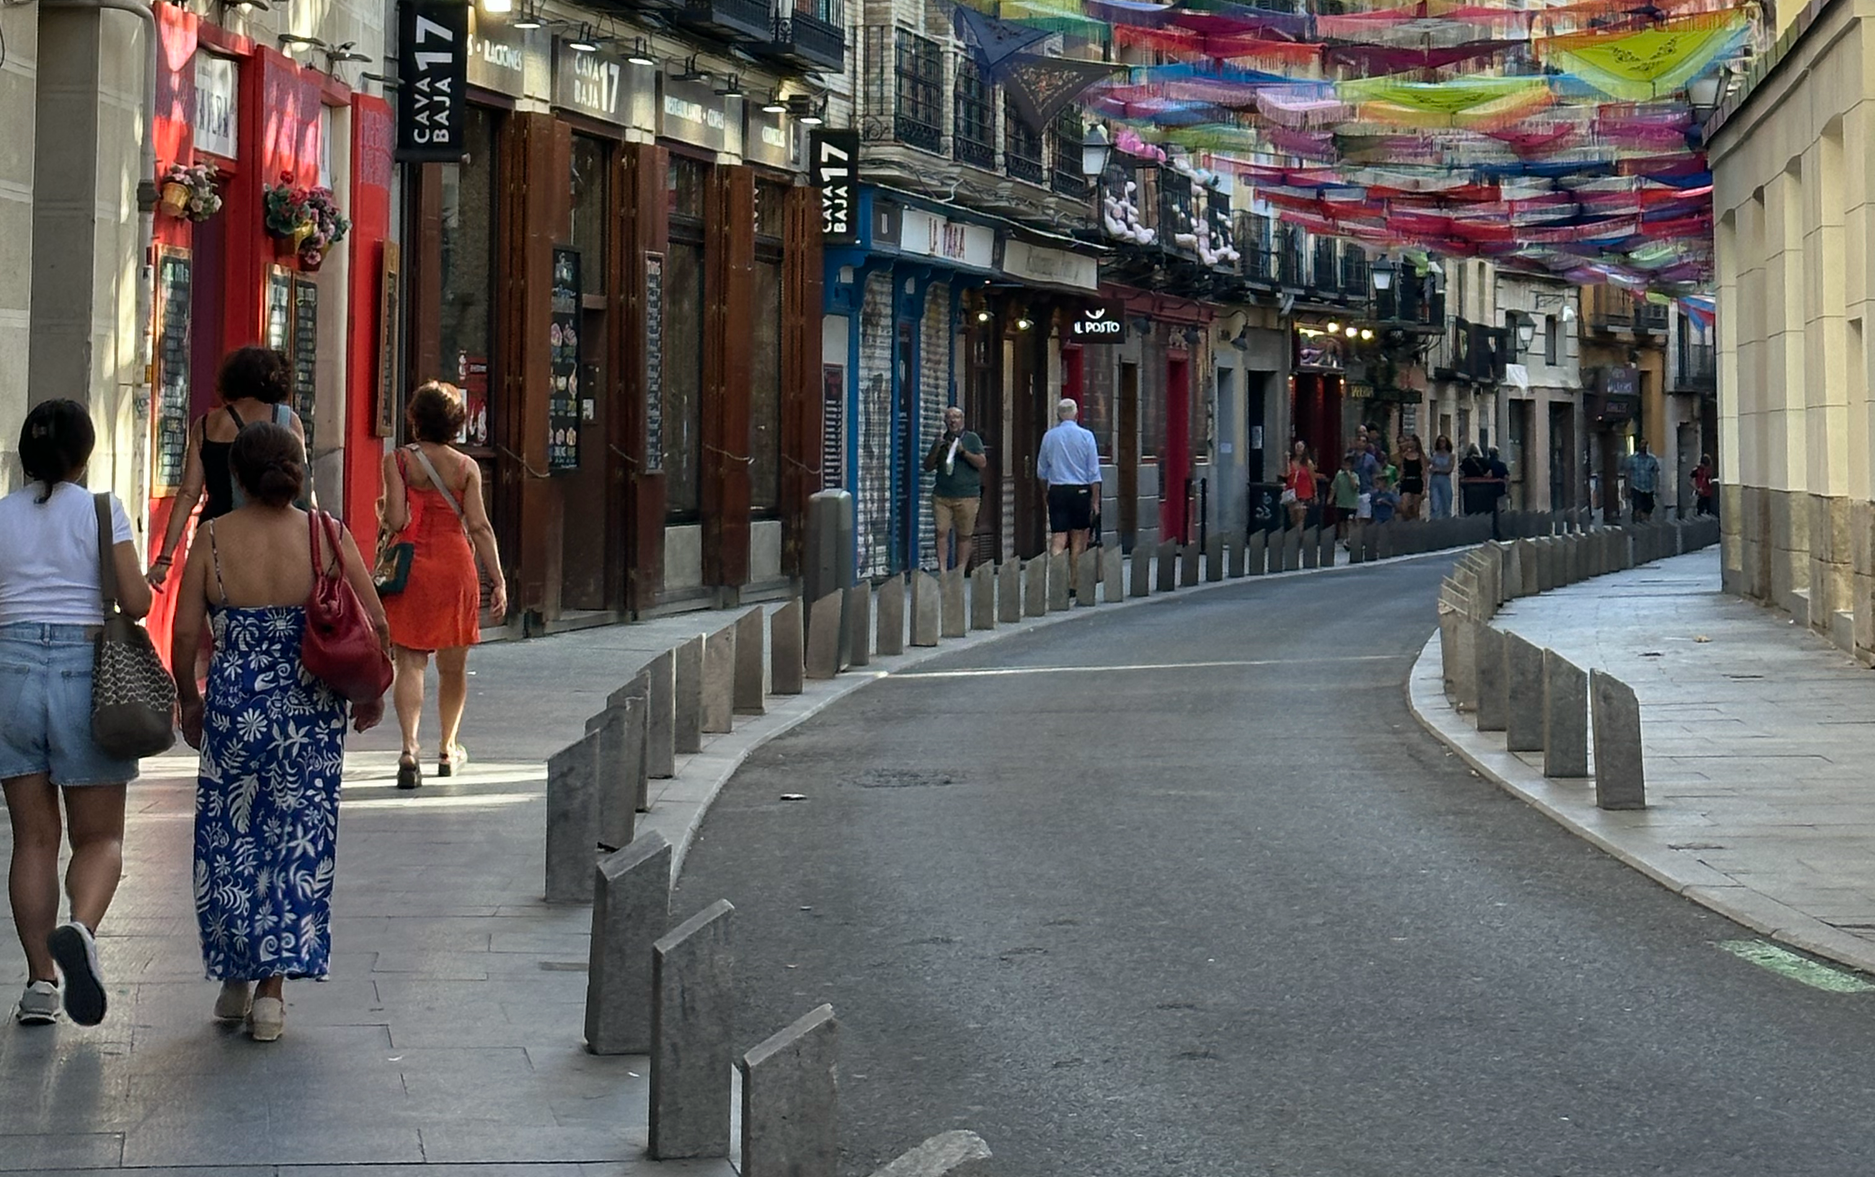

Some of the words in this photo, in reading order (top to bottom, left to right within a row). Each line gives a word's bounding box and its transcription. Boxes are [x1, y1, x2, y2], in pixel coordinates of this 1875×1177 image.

[414, 14, 453, 72] 17
[484, 39, 522, 72] RACIONES
[575, 52, 599, 82] CAVA
[414, 77, 431, 144] CAVA
[433, 77, 452, 143] BAJA
[574, 79, 599, 110] BAJA
[600, 60, 620, 114] 17
[820, 141, 848, 182] 17
[822, 185, 833, 233] CAVA
[834, 185, 848, 233] BAJA
[1074, 321, 1083, 334] IL
[1085, 321, 1120, 333] POSTO
